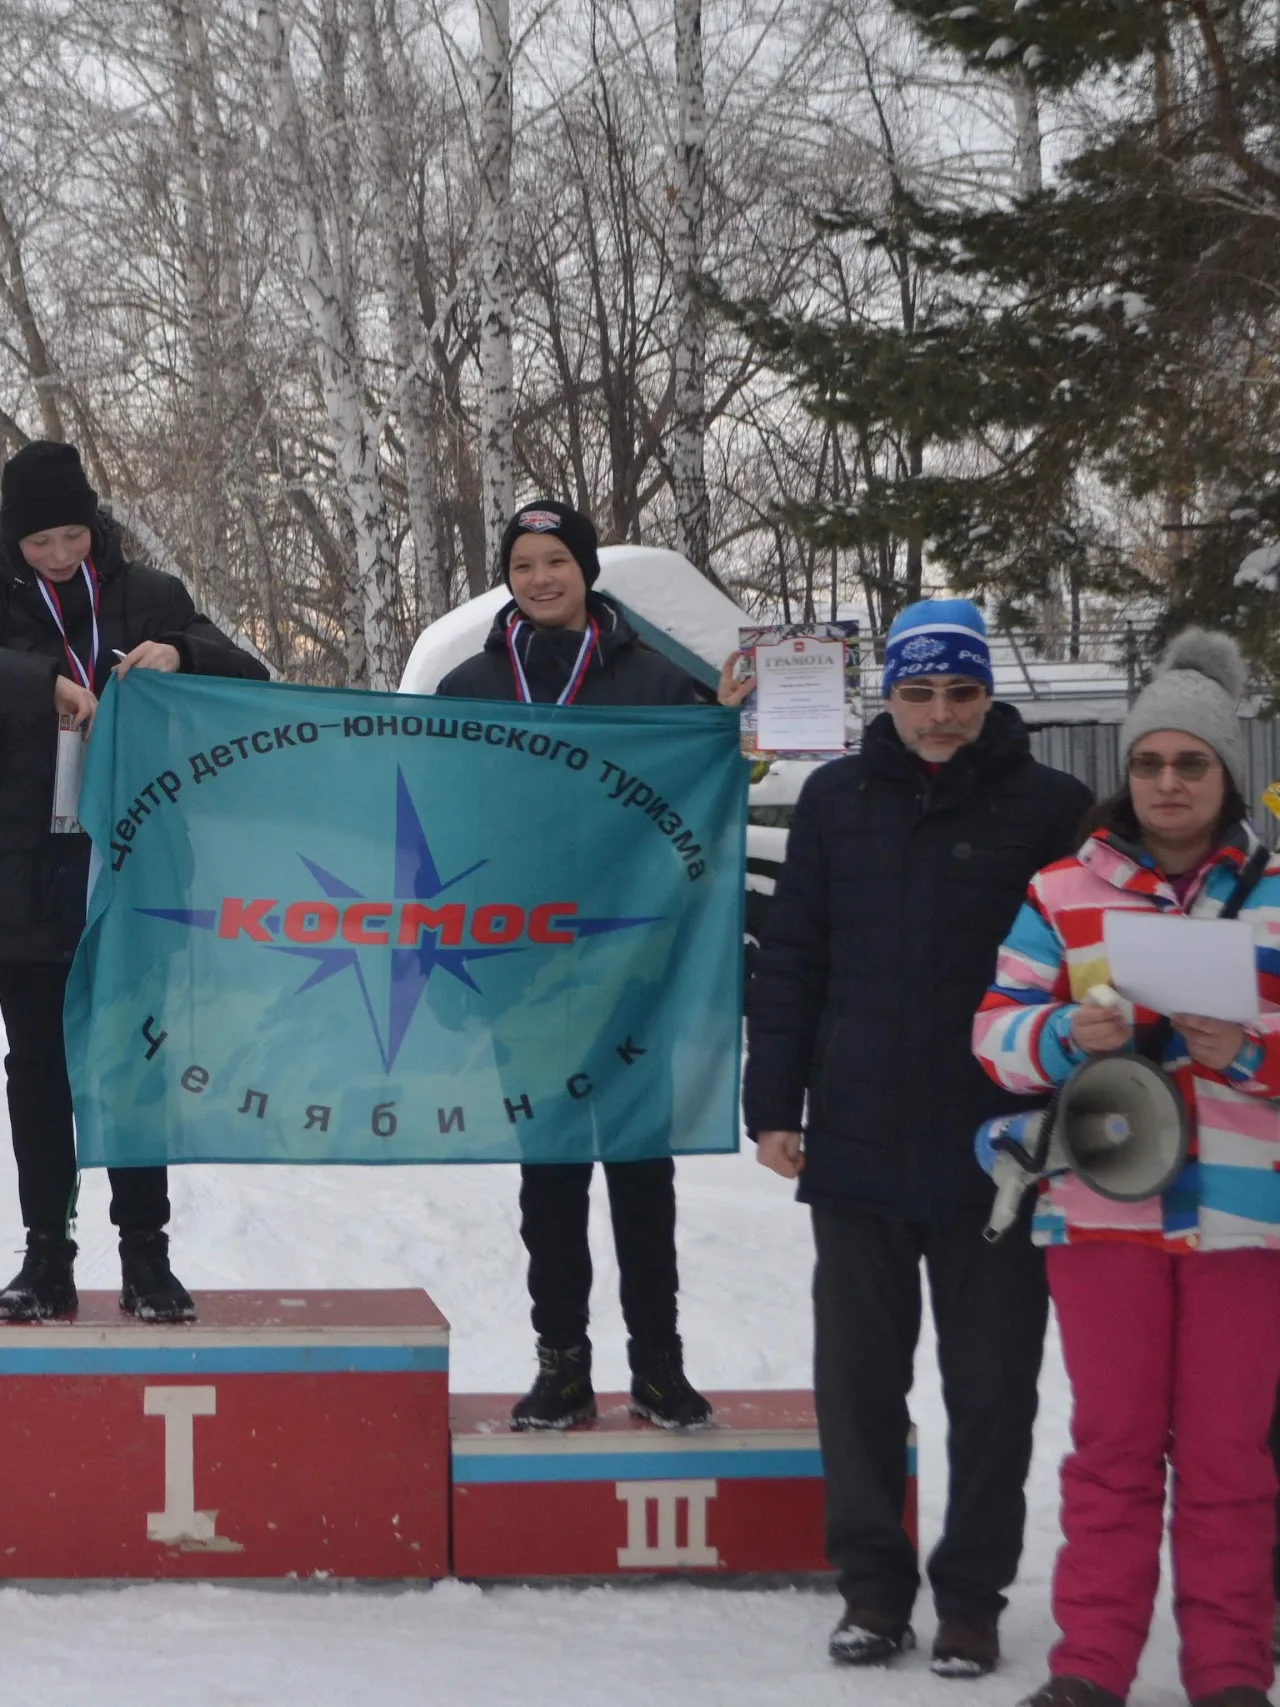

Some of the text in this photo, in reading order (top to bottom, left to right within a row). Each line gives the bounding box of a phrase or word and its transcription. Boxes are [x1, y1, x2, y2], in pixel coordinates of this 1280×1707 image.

[765, 656, 834, 667] ГРАМОТА
[897, 662, 950, 677] 2014
[110, 714, 708, 882] Центр детско-юношеского туризма
[217, 896, 579, 946] КОСМОС
[140, 1015, 649, 1138] Челябинск
[615, 1478, 718, 1568] III
